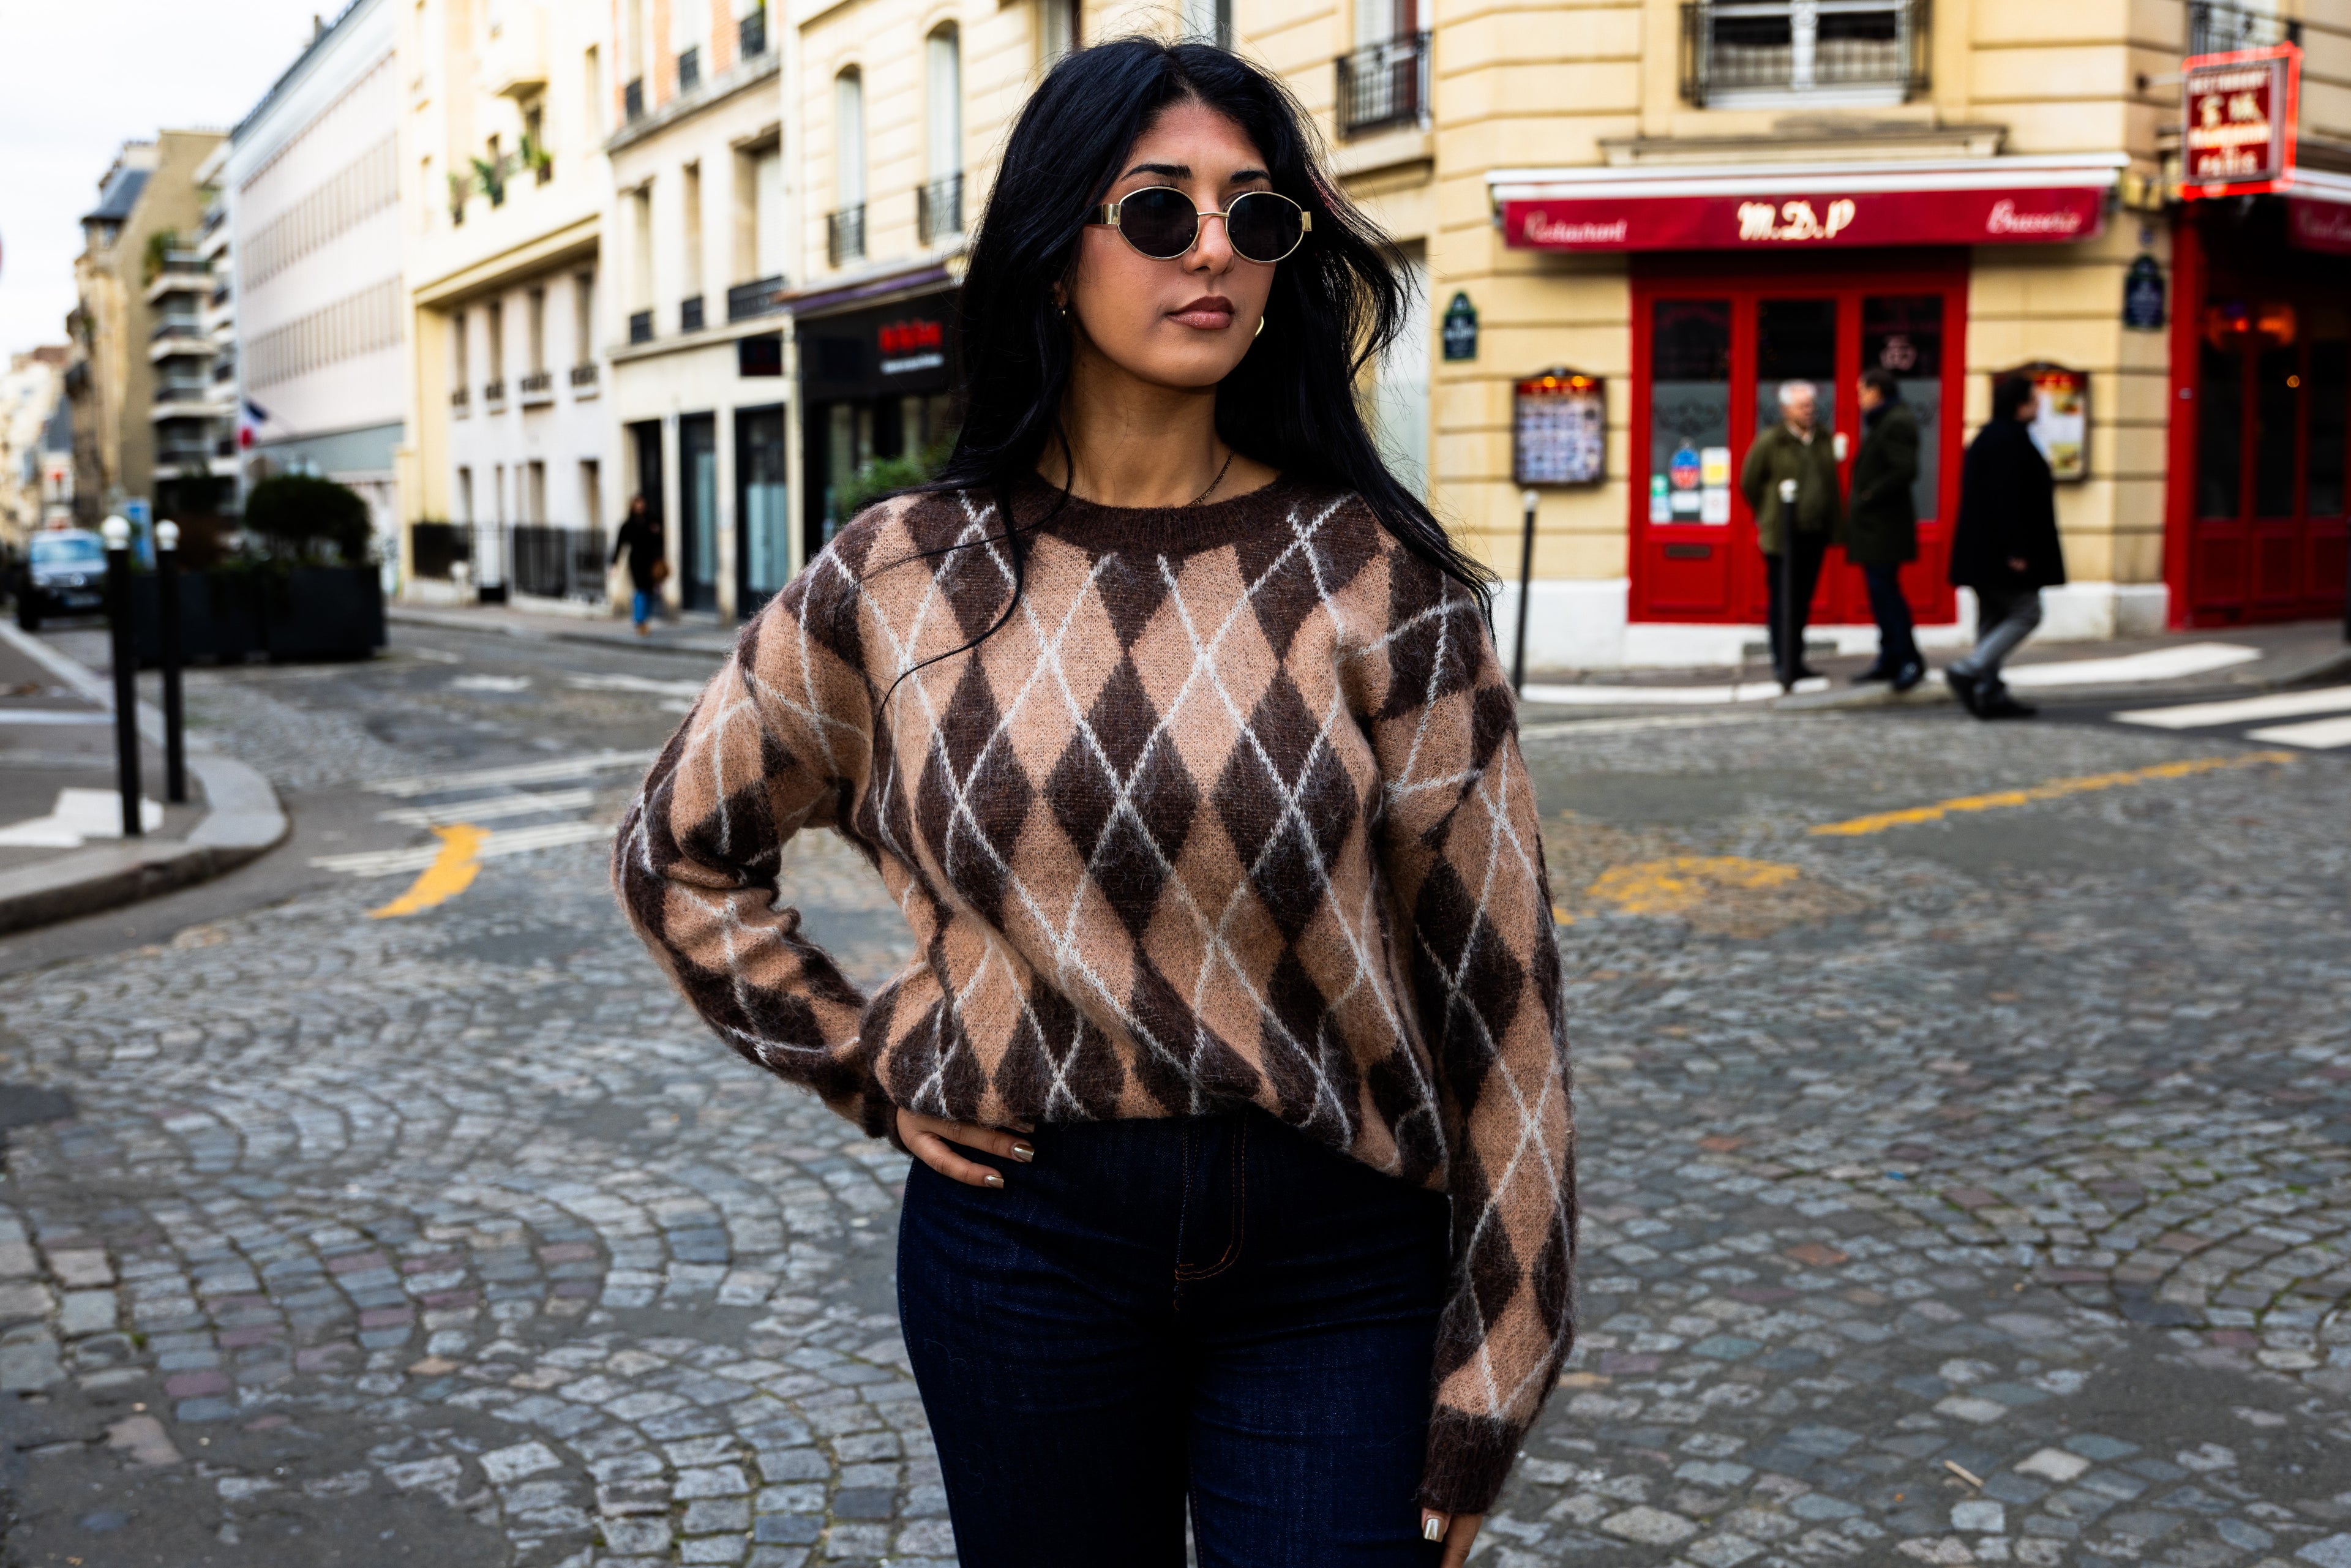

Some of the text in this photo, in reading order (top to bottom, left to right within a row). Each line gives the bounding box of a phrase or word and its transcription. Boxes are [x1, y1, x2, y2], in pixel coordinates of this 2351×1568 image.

[1524, 198, 2082, 243] Restaurant M.D.P Brasserie
